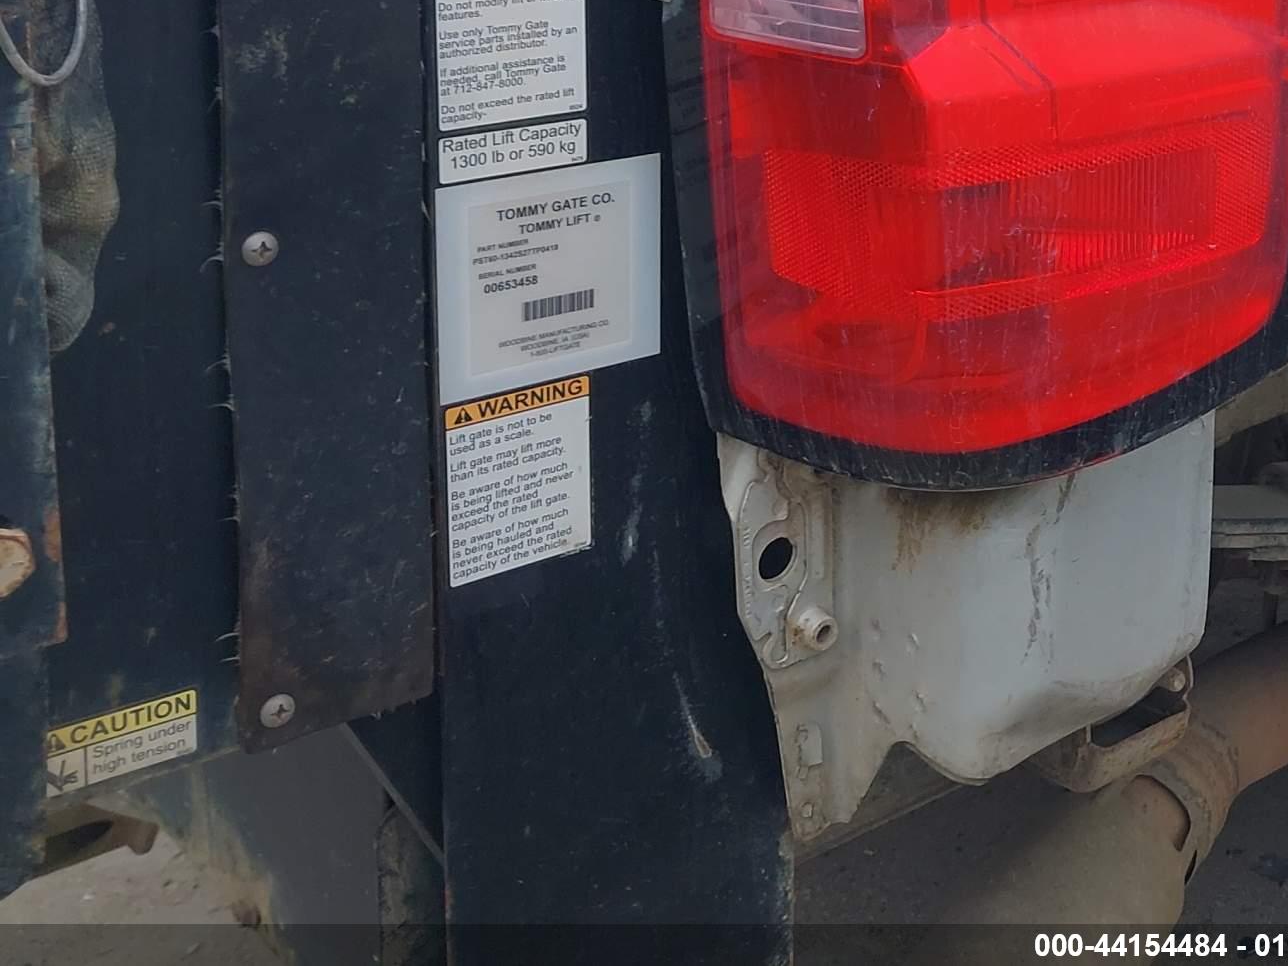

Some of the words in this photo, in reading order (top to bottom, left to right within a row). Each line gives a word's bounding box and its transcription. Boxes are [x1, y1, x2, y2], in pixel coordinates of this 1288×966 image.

[438, 3, 452, 11] Do
[456, 1, 472, 10] not
[439, 31, 459, 40] Use
[463, 27, 483, 39] only
[487, 24, 522, 34] Tommy
[525, 20, 549, 29] Gate
[439, 38, 476, 49] service
[479, 33, 504, 45] parts
[507, 29, 548, 41] installed
[552, 27, 562, 37] by
[566, 26, 578, 34] an
[440, 46, 493, 59] authorized
[440, 68, 447, 77] If
[450, 63, 498, 76] additional
[502, 56, 554, 68] assistance
[485, 71, 502, 81] call
[506, 67, 539, 78] Tommy
[544, 63, 566, 73] Gate
[441, 88, 450, 96] at
[442, 106, 455, 115] Do
[459, 103, 475, 112] not
[478, 97, 514, 108] exceed
[517, 95, 533, 103] the
[535, 90, 560, 100] rated
[563, 88, 574, 96] lift
[443, 136, 487, 153] Rated
[493, 132, 515, 146] Lift
[519, 123, 582, 141] Capacity
[451, 153, 487, 169] 1300
[492, 150, 504, 163] lb
[509, 150, 524, 160] or
[528, 142, 555, 157] 590
[560, 141, 576, 154] kg
[496, 202, 548, 221] TOMMY
[552, 196, 588, 212] GATE
[592, 192, 615, 206] CO.
[519, 218, 563, 234] TOMMY
[566, 213, 592, 227] LIFT
[477, 244, 496, 253] PART
[498, 239, 529, 249] NUMBER
[478, 269, 504, 280] SERIAL
[506, 263, 537, 275] NUMBER
[484, 275, 538, 294] 00653458
[478, 379, 583, 418] WARNING
[449, 435, 466, 445] Lift
[469, 429, 492, 442] gate
[495, 425, 504, 433] is
[507, 420, 524, 430] not
[527, 417, 537, 425] to
[540, 413, 552, 423] be
[450, 442, 476, 456] used
[479, 440, 491, 448] as
[504, 429, 534, 442] scale.
[450, 461, 467, 472] Lift
[470, 455, 493, 469] gate
[496, 448, 518, 459] may
[521, 442, 533, 453] lift
[536, 437, 561, 449] more
[451, 470, 474, 483] than
[477, 465, 489, 476] its
[492, 457, 519, 471] rated
[522, 446, 565, 464] capacity.
[451, 491, 466, 501] Be
[469, 483, 500, 496] aware
[504, 476, 514, 486] of
[517, 471, 538, 482] how
[541, 462, 568, 475] much
[451, 502, 460, 511] is
[464, 494, 492, 508] being
[495, 484, 520, 499] lifted
[524, 480, 542, 492] and
[546, 470, 573, 484] never
[452, 503, 489, 521] exceed
[493, 499, 509, 510] the
[512, 489, 538, 504] rated
[452, 514, 495, 532] capacity
[498, 508, 508, 518] of
[512, 503, 527, 514] the
[530, 497, 542, 508] lift
[546, 493, 570, 507] gate.
[453, 539, 467, 549] Be
[470, 529, 502, 544] aware
[505, 523, 515, 534] of
[518, 517, 539, 529] how
[542, 508, 568, 522] much
[453, 550, 461, 559] is
[465, 541, 494, 556] being
[497, 528, 532, 546] hauled
[535, 522, 554, 534] and
[453, 555, 483, 569] never
[486, 541, 524, 560] exceed
[527, 536, 543, 547] the
[546, 526, 572, 540] rated
[453, 560, 497, 580] capacity
[500, 554, 511, 565] of
[513, 549, 529, 561] the
[70, 694, 191, 744] CAUTION
[93, 734, 144, 758] Spring
[149, 720, 191, 741] under
[93, 756, 126, 774] high
[131, 738, 186, 762] tension
